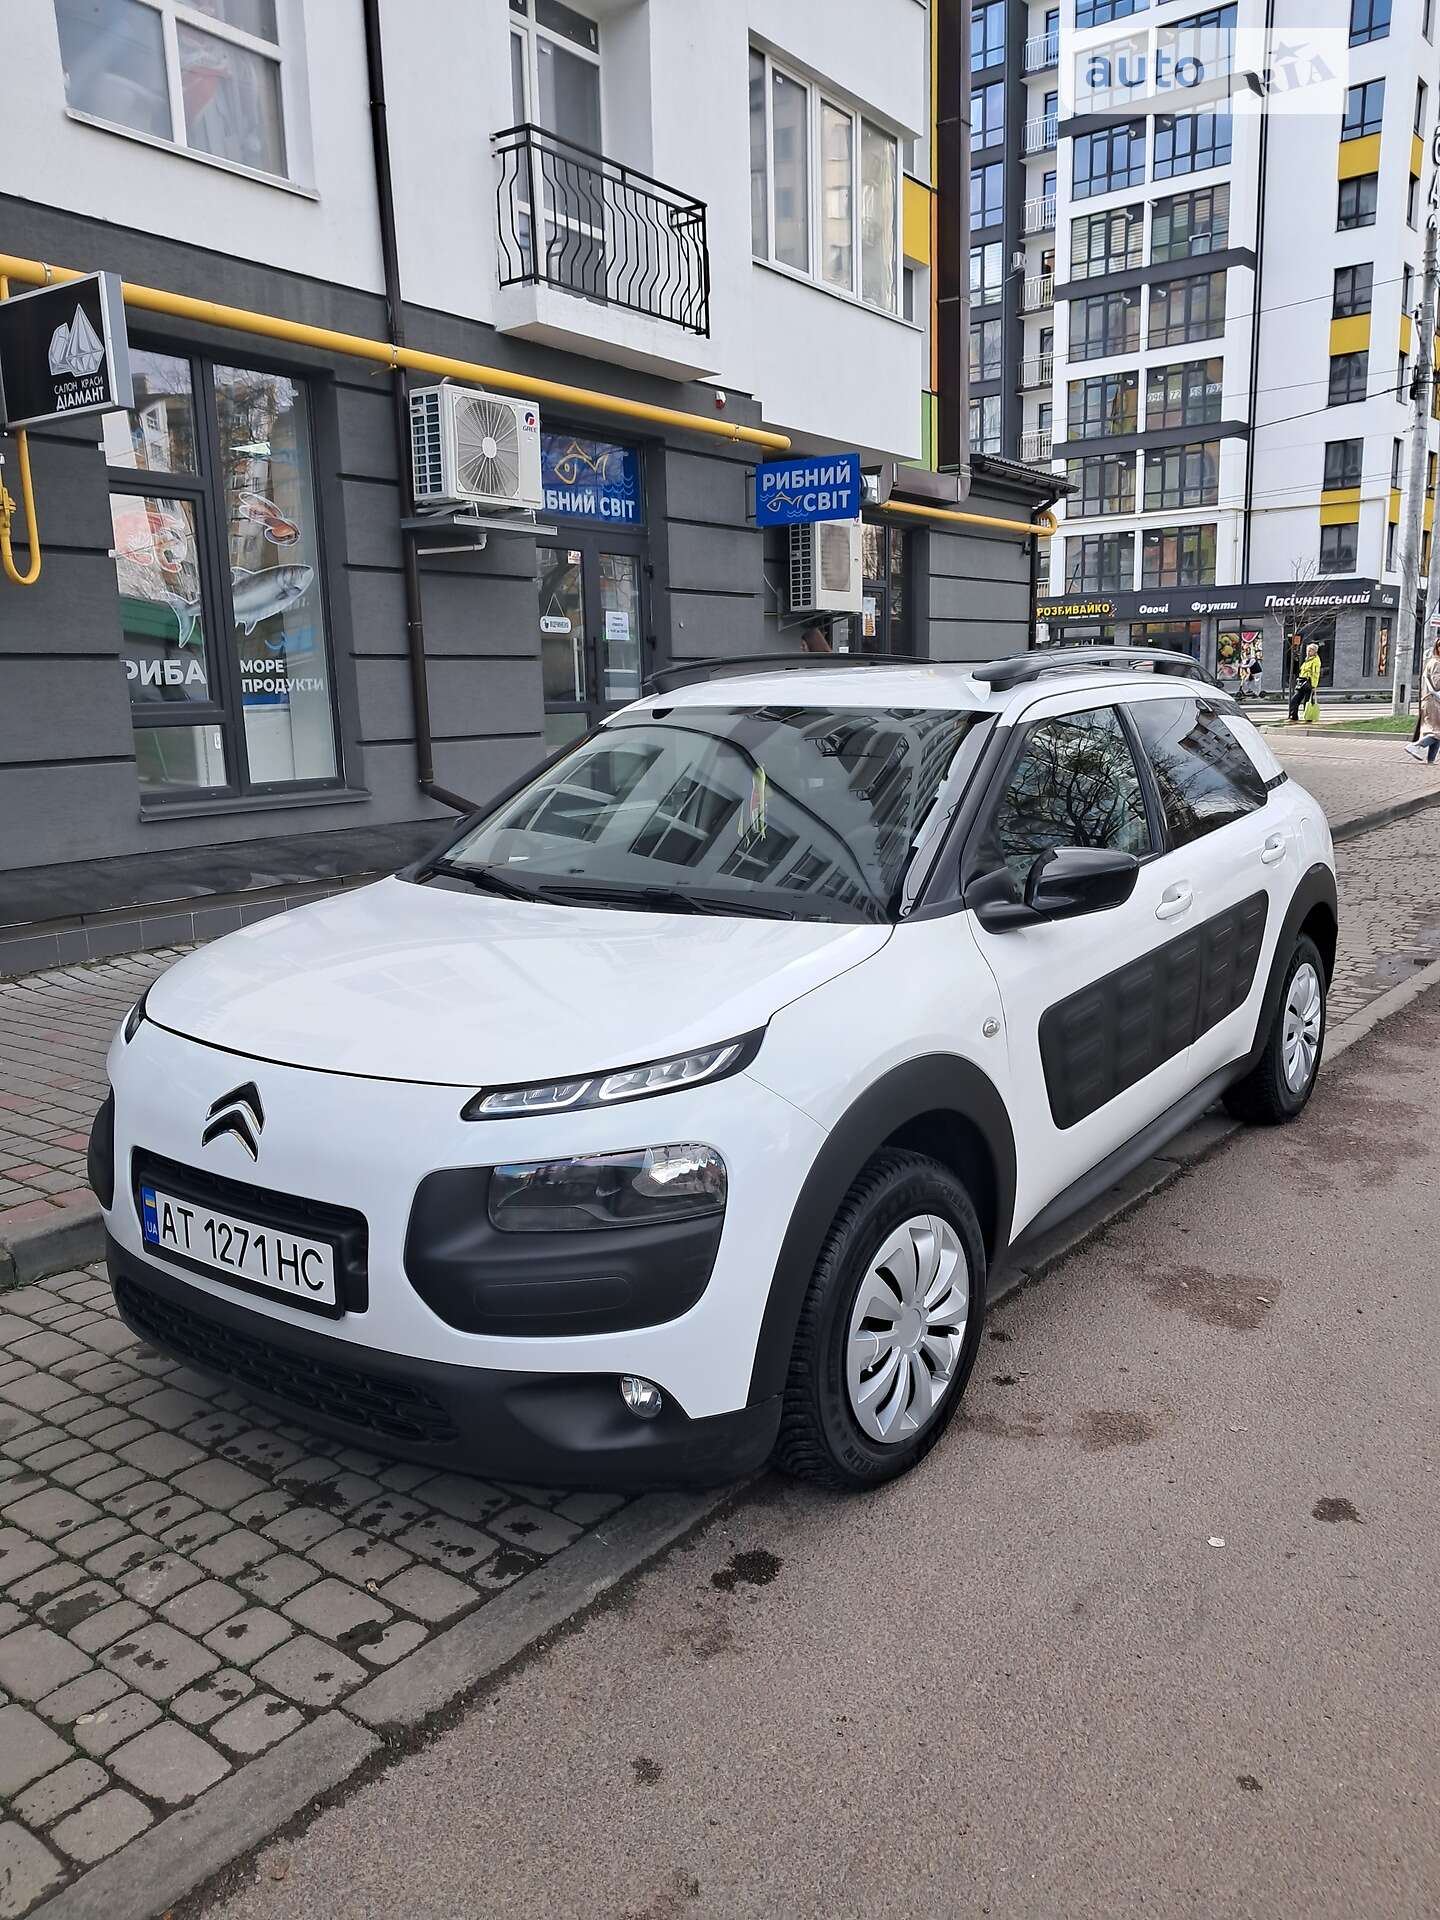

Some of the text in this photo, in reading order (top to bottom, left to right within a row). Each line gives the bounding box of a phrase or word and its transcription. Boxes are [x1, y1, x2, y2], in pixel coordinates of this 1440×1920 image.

[54, 375, 104, 395] САЛОН КРАСИ
[56, 386, 105, 411] ДІАМАНТ
[762, 460, 851, 492] РИБНИЙ
[543, 489, 635, 519] БНИЙ СВІТ
[803, 489, 851, 512] СВІТ
[1191, 601, 1238, 613] Фрукти
[1264, 590, 1371, 608] Пасічнянський
[1036, 602, 1111, 618] РОЗБИВАЙКО
[1139, 603, 1169, 614] Овочі
[240, 659, 285, 674] МОРЕ
[241, 677, 324, 695] ПРОДУКТИ
[147, 1221, 158, 1236] UA
[162, 1201, 325, 1291] AT 1271 HC
